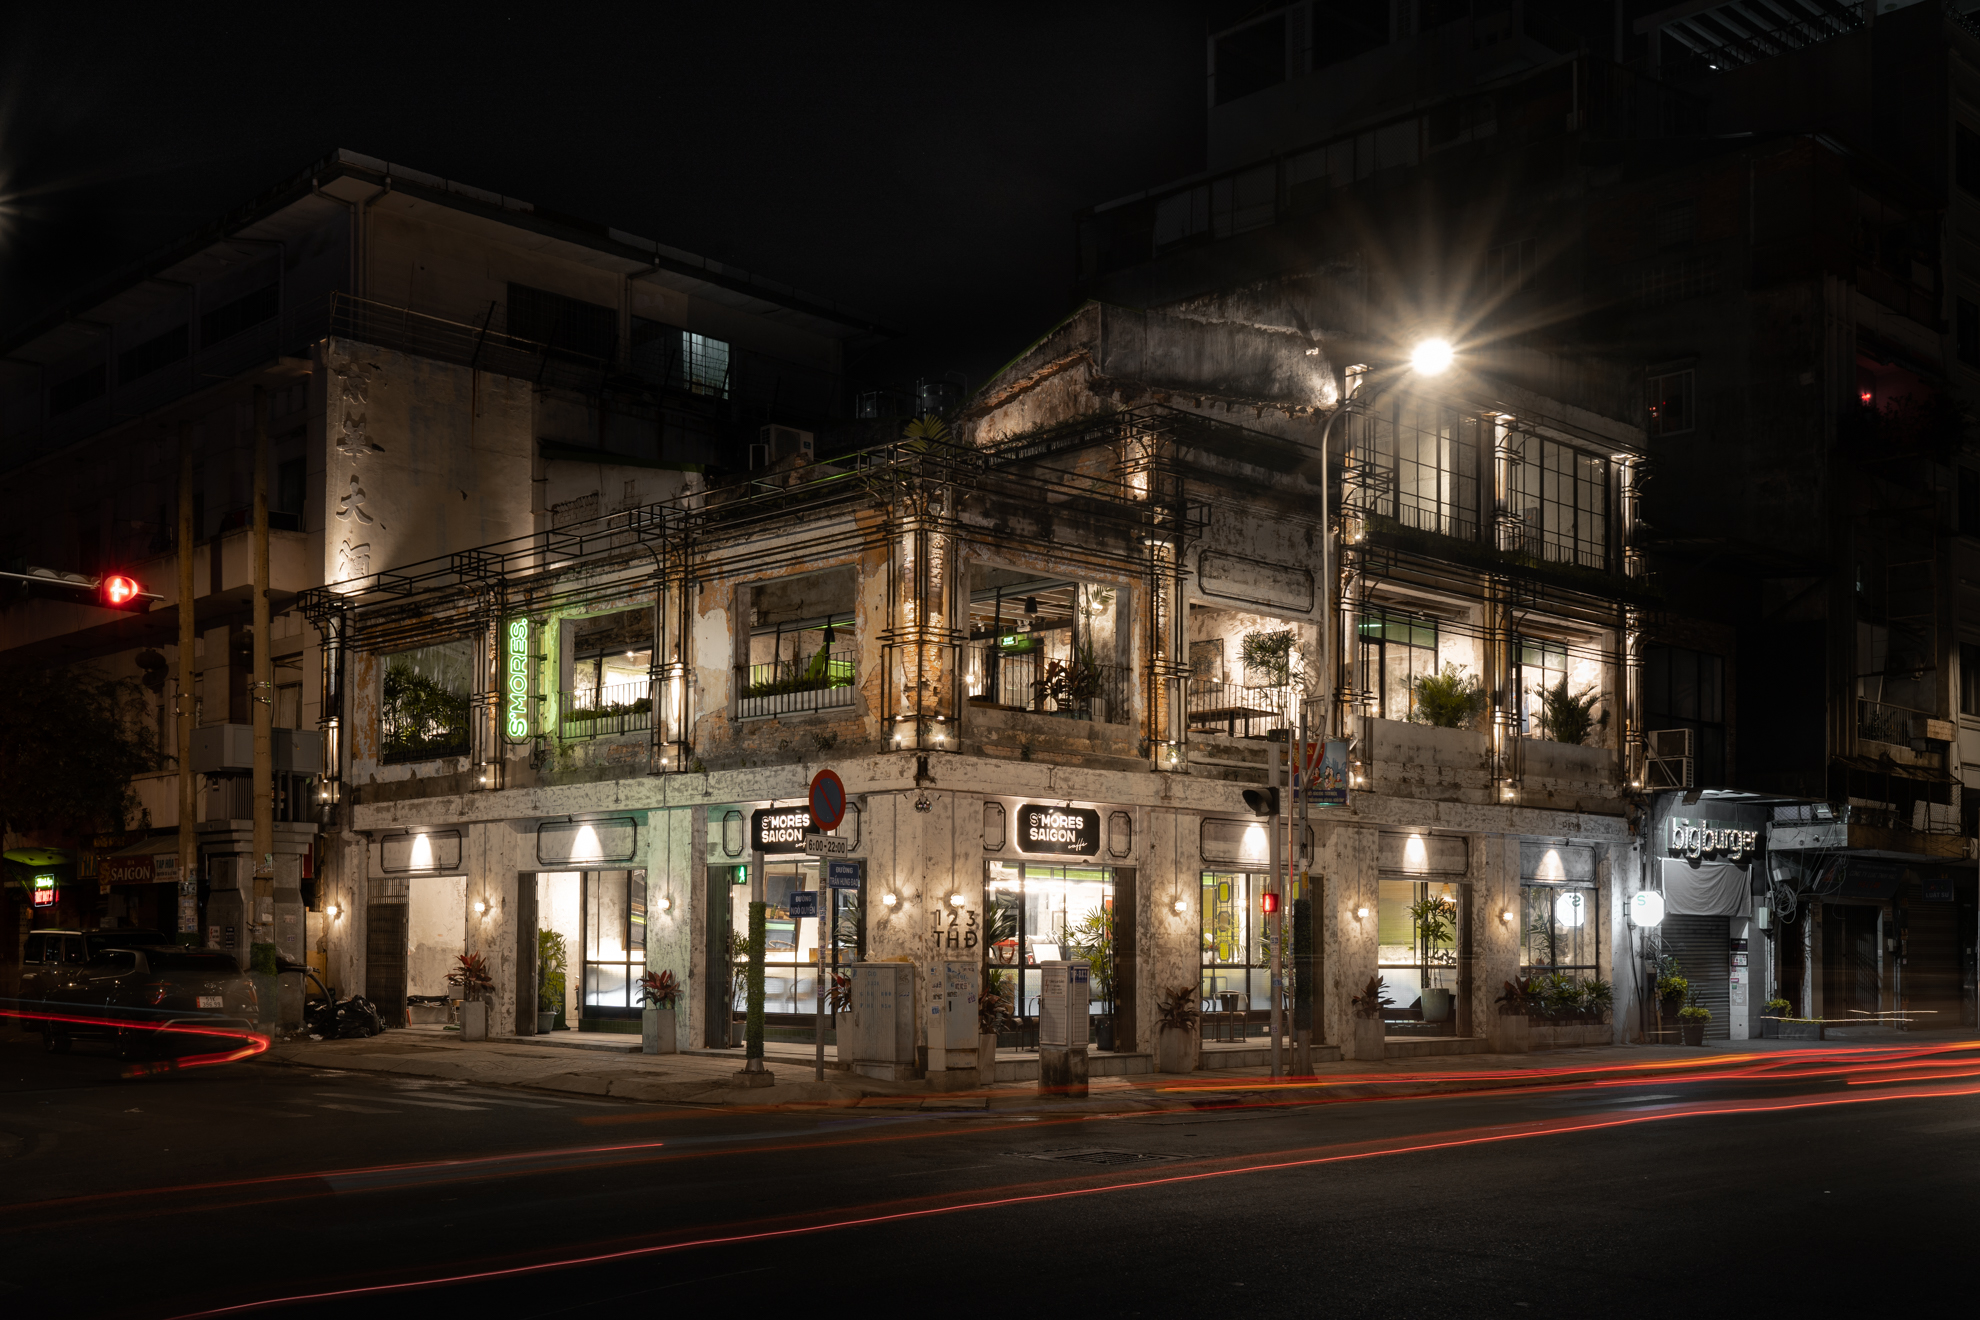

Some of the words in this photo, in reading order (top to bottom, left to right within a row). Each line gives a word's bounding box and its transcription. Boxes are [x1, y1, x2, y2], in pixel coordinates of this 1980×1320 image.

[761, 828, 803, 843] SAIGON
[1029, 827, 1076, 843] SAIGON
[1667, 816, 1759, 860] bigburger
[111, 865, 151, 881] SAIGON
